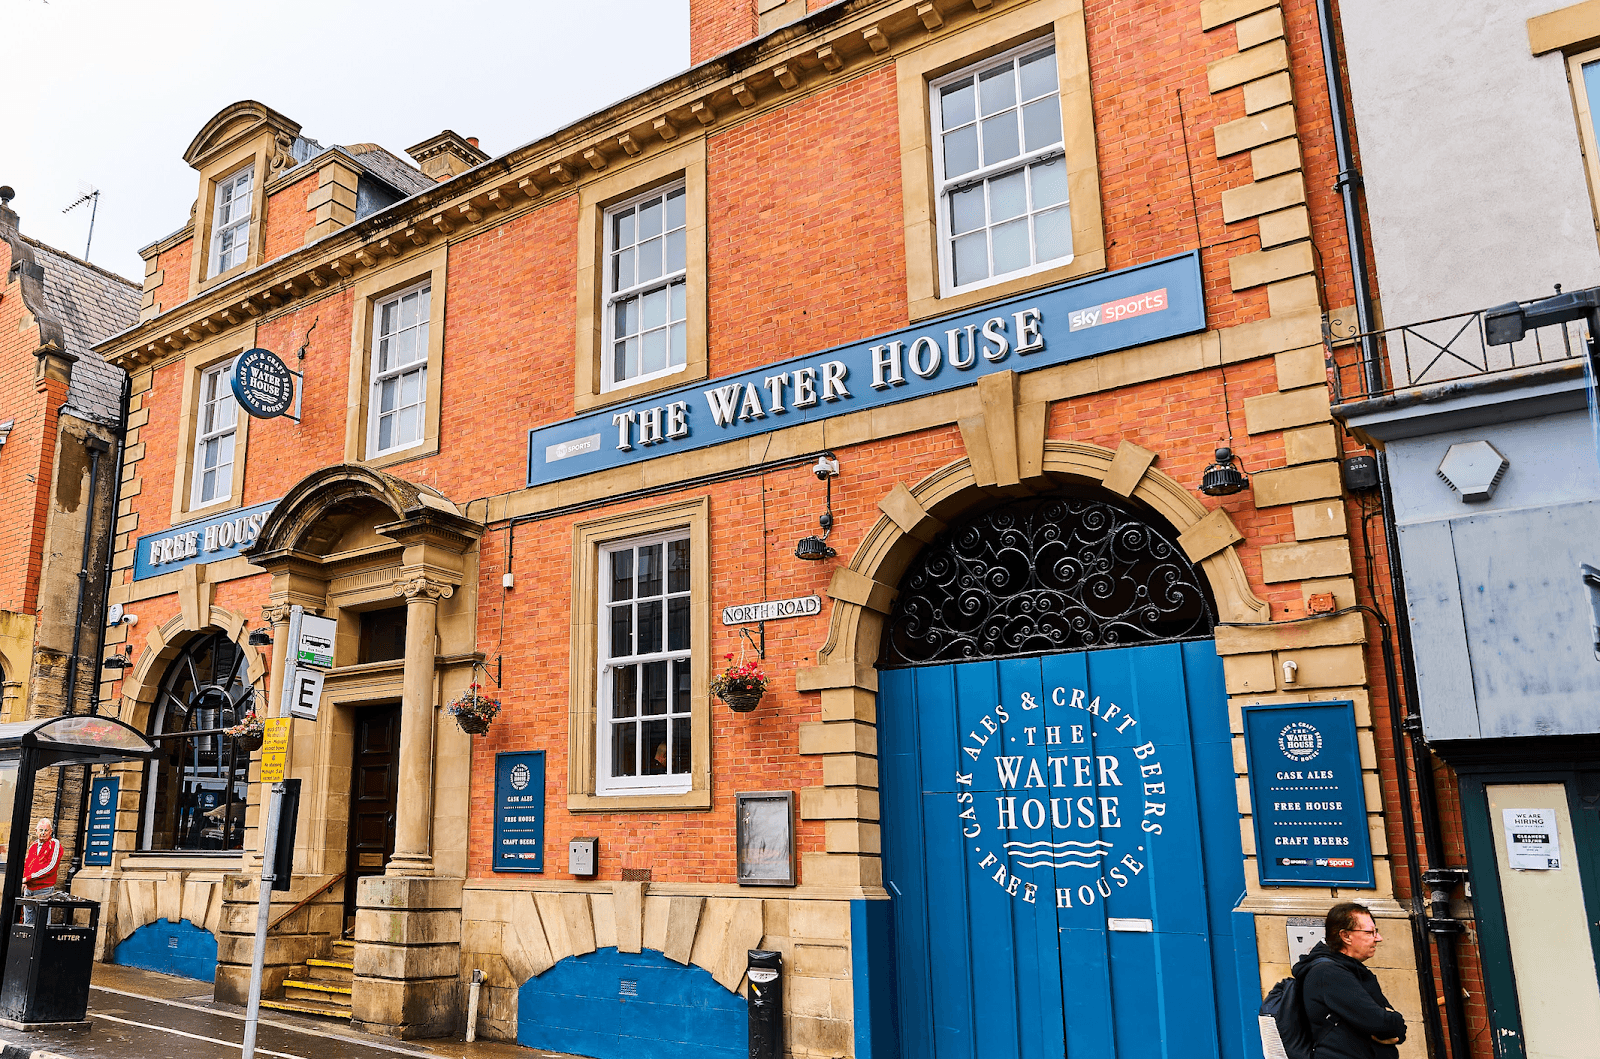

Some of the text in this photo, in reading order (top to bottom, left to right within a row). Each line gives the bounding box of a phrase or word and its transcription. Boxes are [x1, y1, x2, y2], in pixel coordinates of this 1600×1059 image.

[1073, 295, 1163, 327] sky sports
[244, 354, 258, 366] ALES
[267, 356, 285, 374] CRAFT
[259, 362, 274, 373] THE
[250, 377, 280, 396] HOUSE
[251, 366, 280, 386] WATER
[612, 307, 1044, 451] THE WATER HOUSE
[244, 390, 284, 412] FREE HOUSE
[568, 442, 591, 453] SPORTS
[149, 531, 199, 566] FREE
[725, 599, 816, 622] NORTH ROAD
[299, 678, 315, 708] E
[1024, 724, 1085, 746] THE
[956, 686, 1166, 838] CASK ALES & CRAFT BEERS
[994, 755, 1123, 789] WATER
[1276, 770, 1334, 780] CASK ALES
[996, 796, 1121, 830] HOUSE
[1274, 802, 1342, 811] FREE HOUSE
[1274, 837, 1349, 846] CRAFT BEERS
[978, 852, 1144, 908] FREE HOUSE
